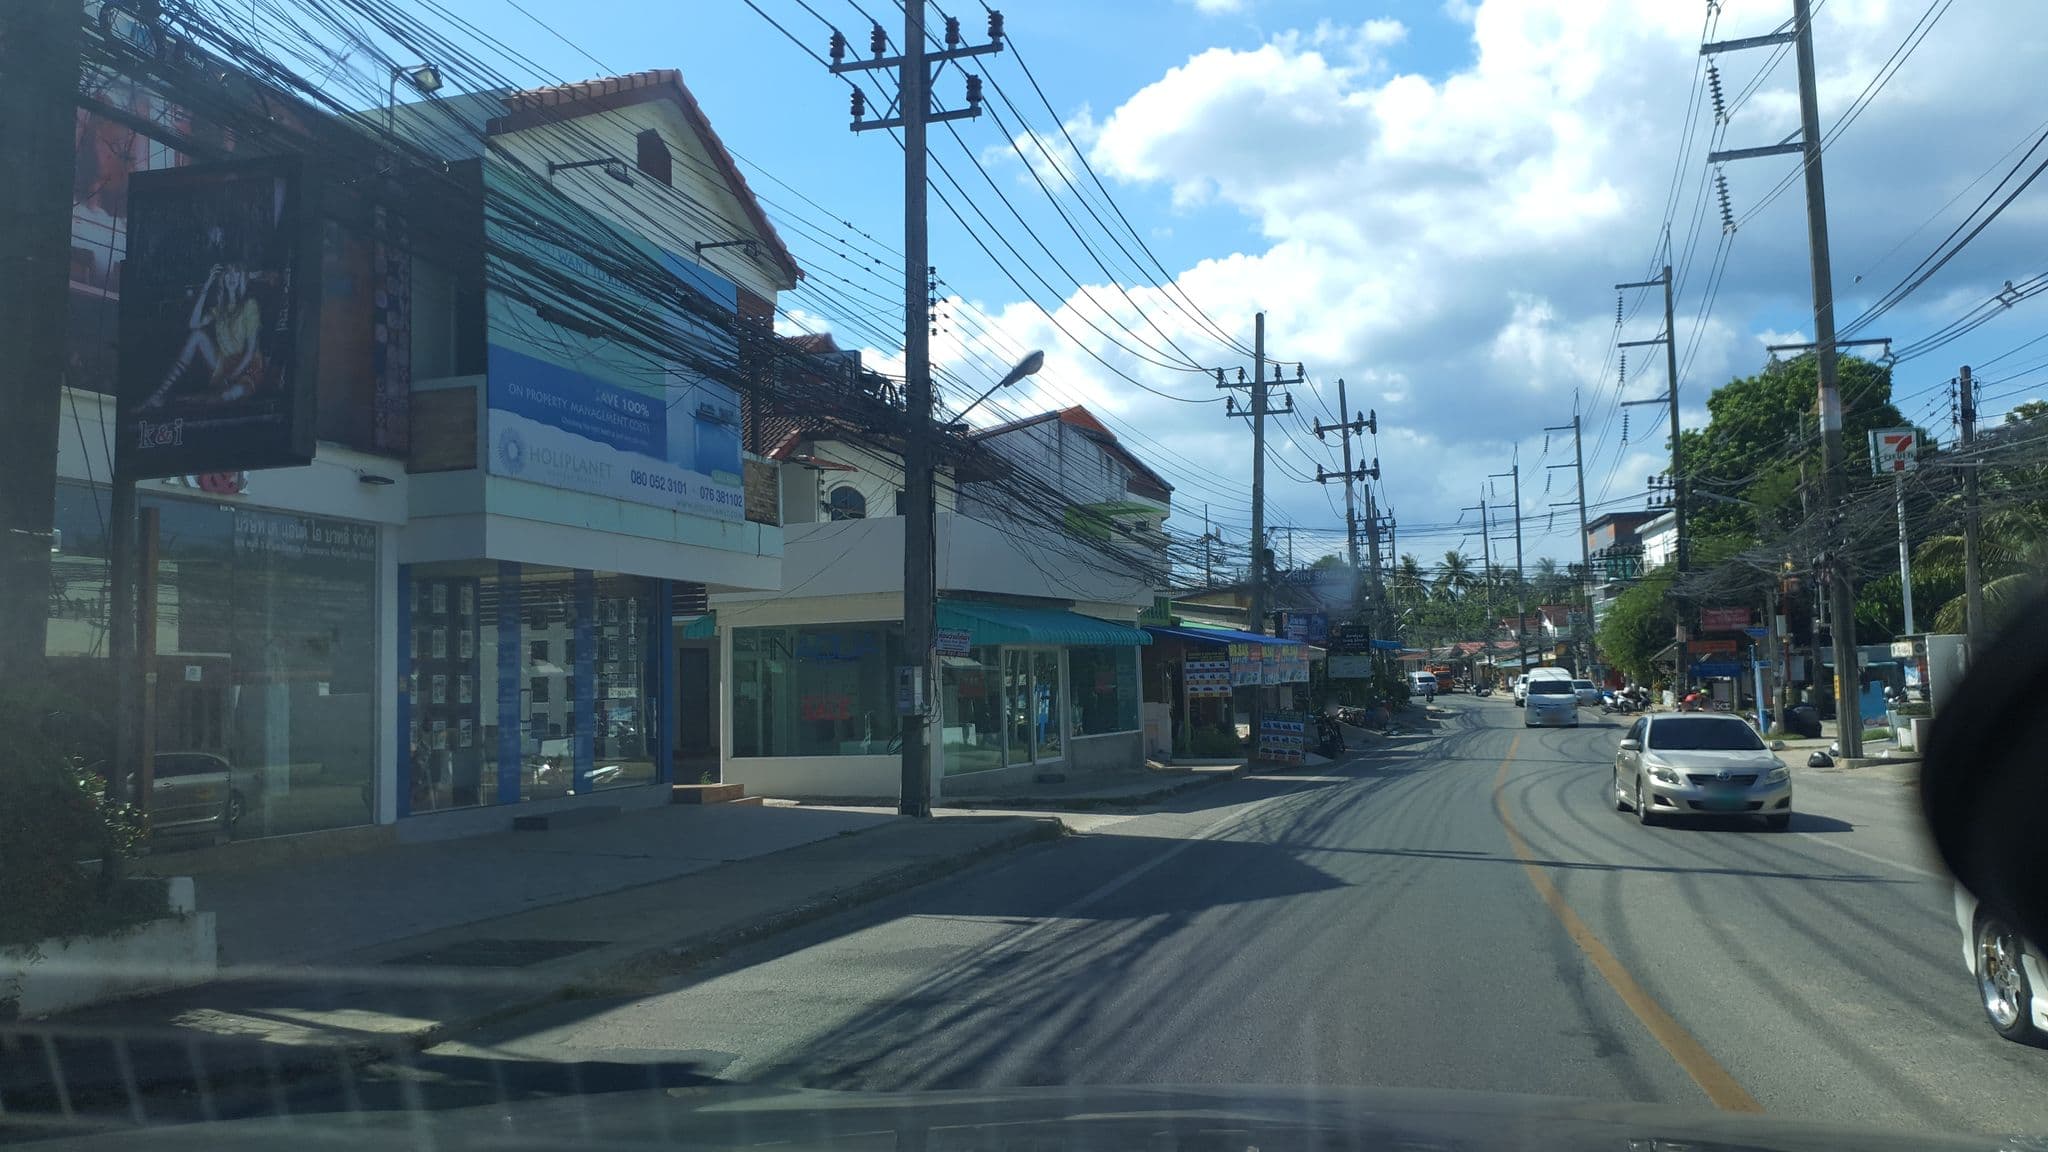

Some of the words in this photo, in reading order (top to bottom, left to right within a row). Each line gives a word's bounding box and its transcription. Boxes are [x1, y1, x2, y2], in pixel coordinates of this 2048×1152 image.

[507, 383, 524, 397] ON
[525, 387, 569, 410] PROPERTY
[570, 402, 629, 429] MANAGEMENT
[622, 400, 650, 418] 100%
[529, 446, 613, 481] HOLIPLANET
[630, 469, 648, 487] 080
[649, 473, 666, 491] 052
[667, 477, 687, 496] 3101
[699, 485, 715, 502] 076
[715, 489, 743, 508] 381102
